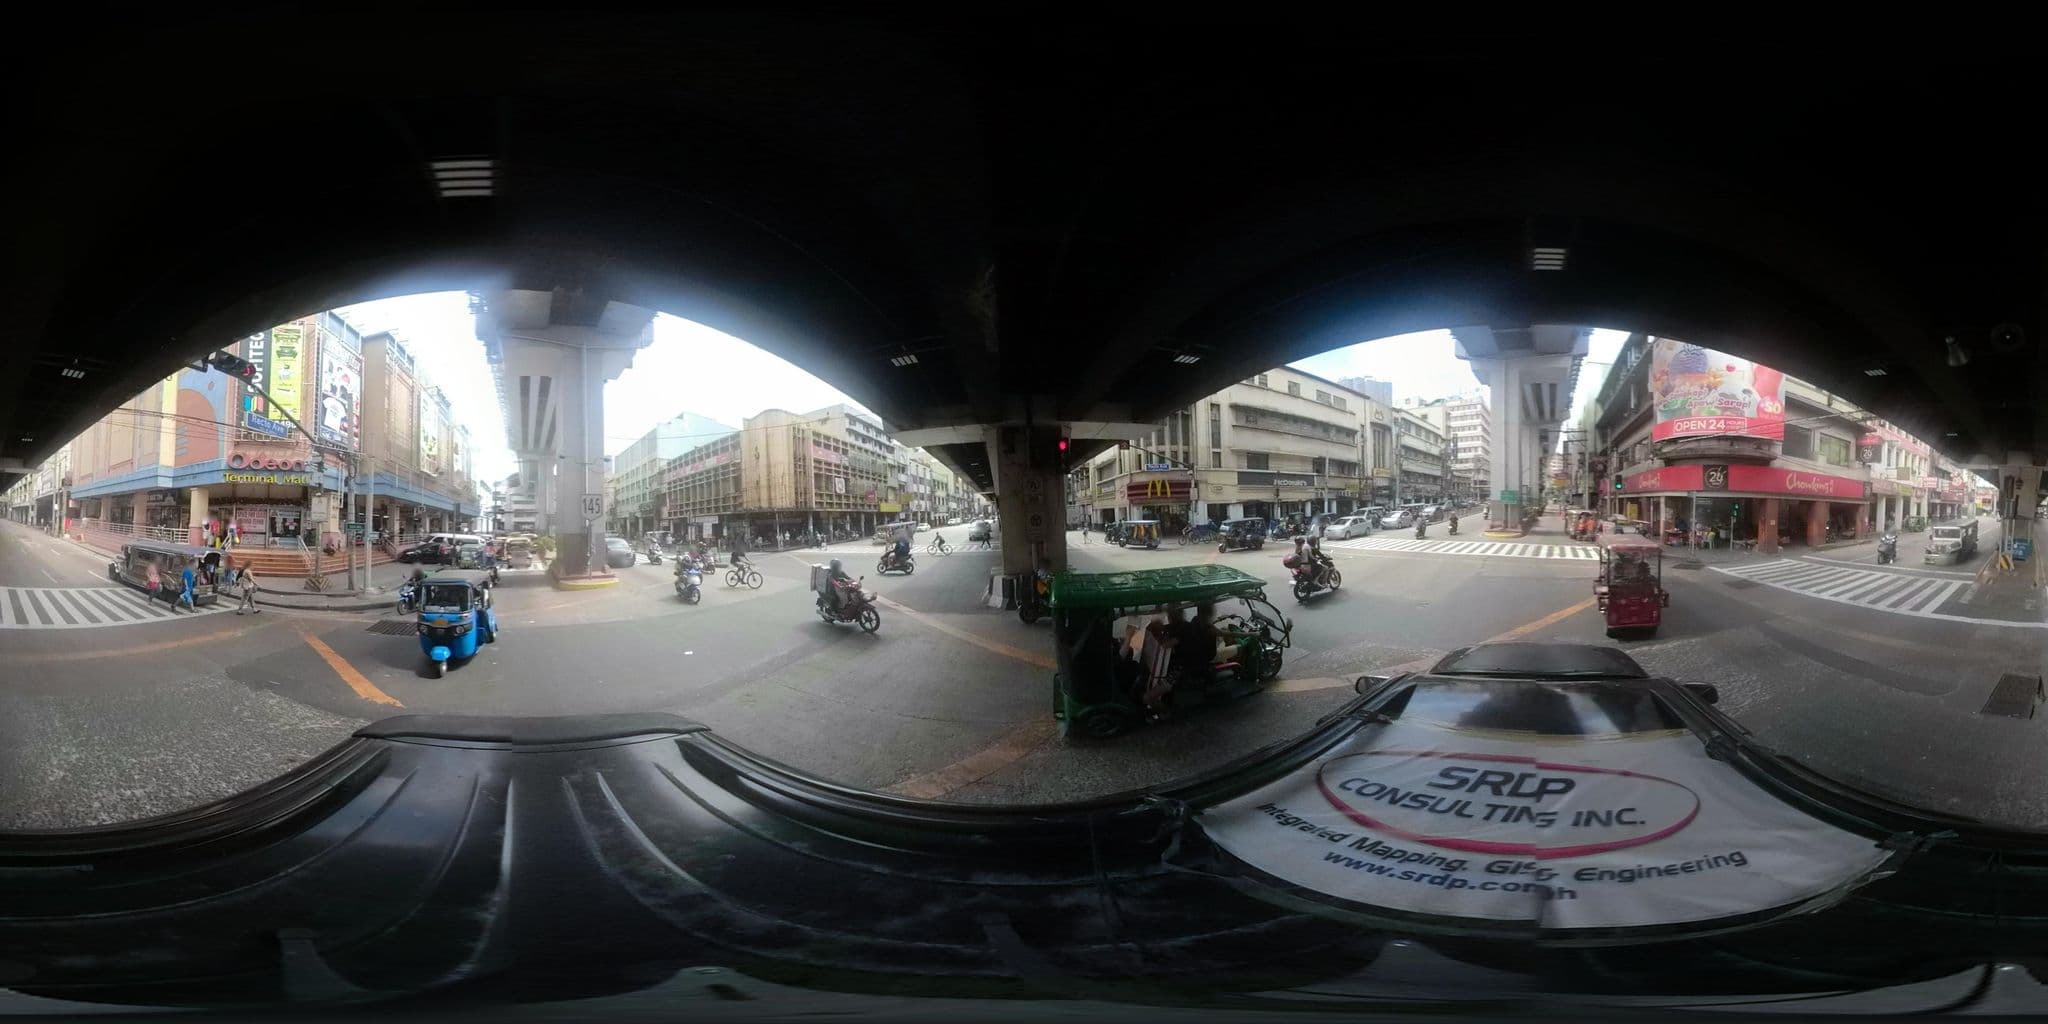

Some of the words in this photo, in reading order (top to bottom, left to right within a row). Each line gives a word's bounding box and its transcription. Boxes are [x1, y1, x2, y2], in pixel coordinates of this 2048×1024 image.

[1674, 420, 1706, 432] OPEN
[1709, 419, 1726, 430] 24
[227, 452, 304, 472] Odeon
[224, 472, 278, 484] Terminal
[583, 498, 600, 514] 145
[1572, 808, 1646, 827] INC.
[1257, 803, 1350, 843] Integrated
[1574, 851, 1748, 883] Engineering
